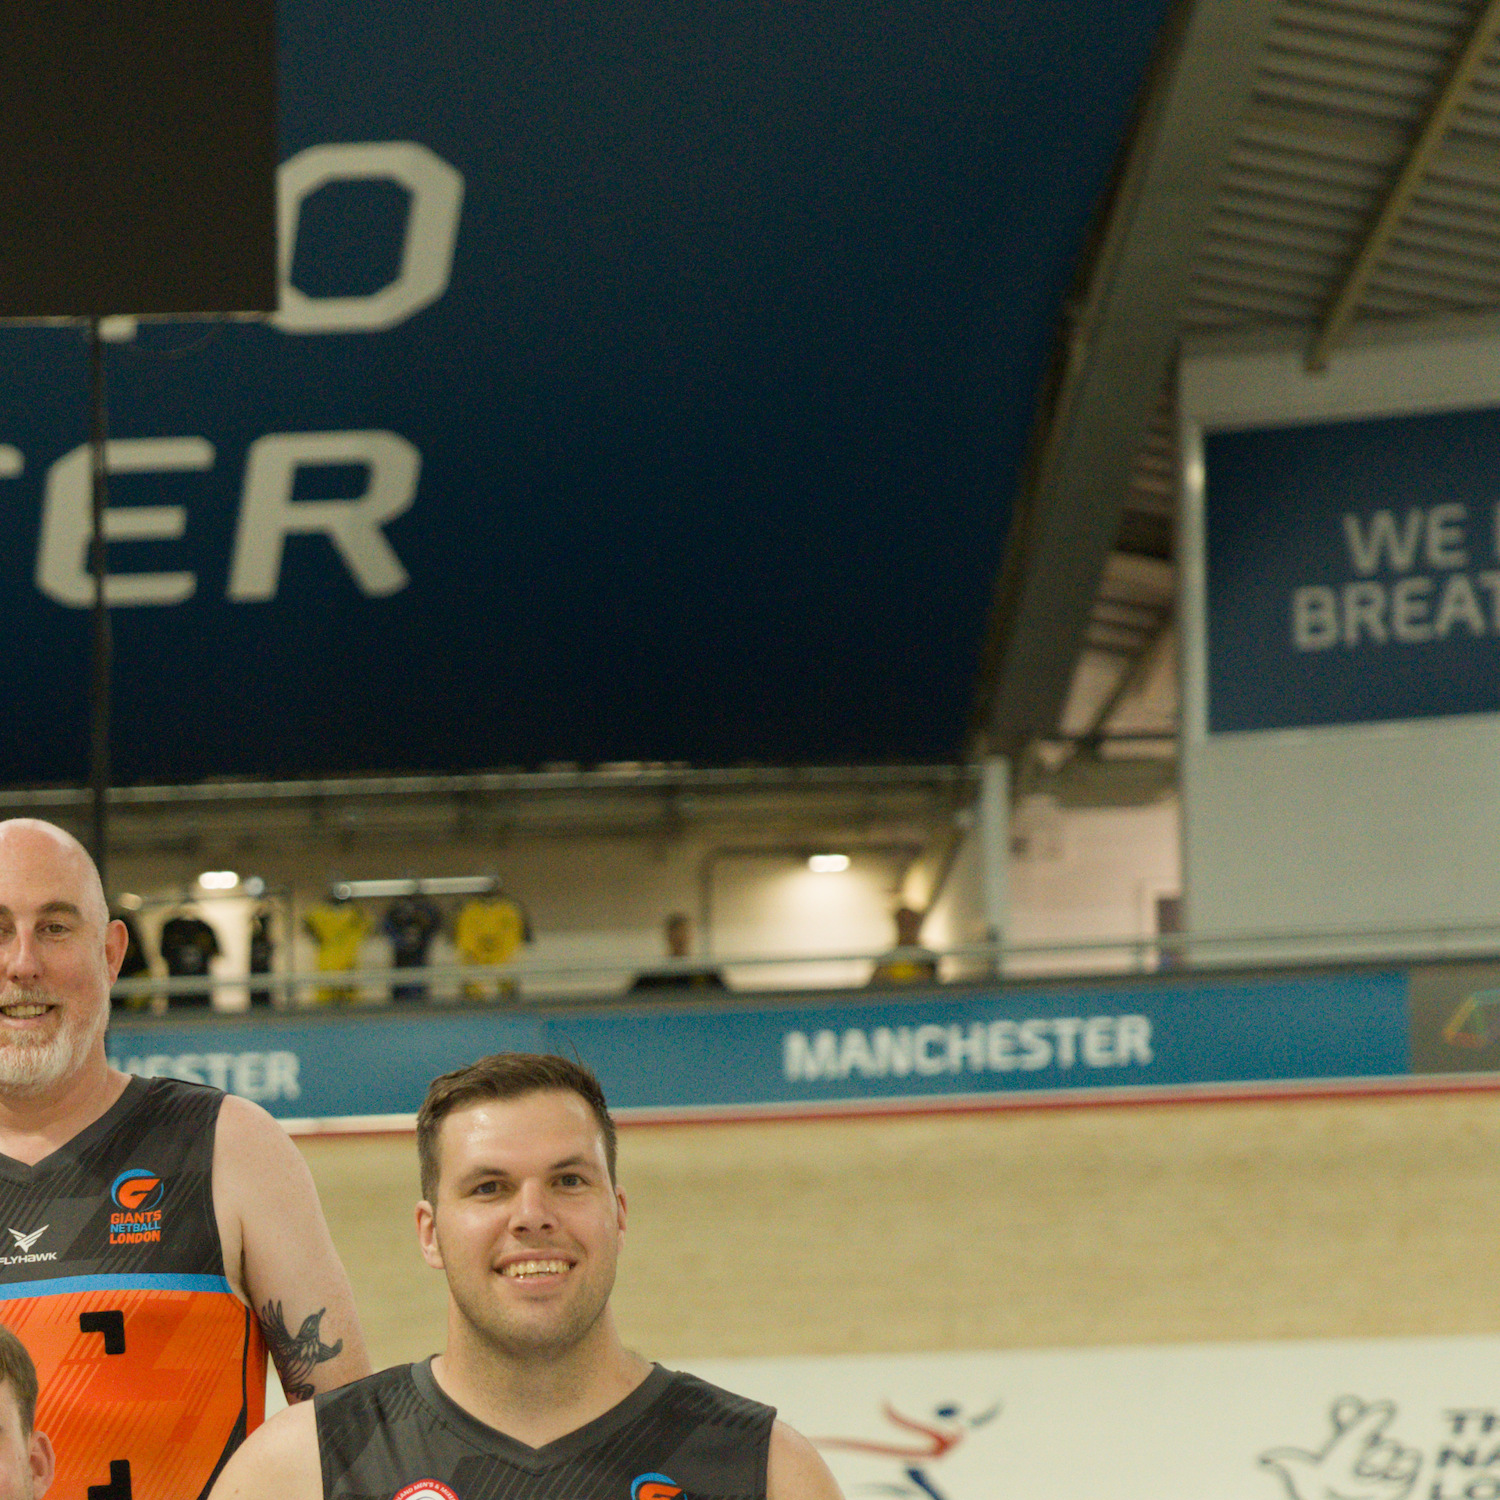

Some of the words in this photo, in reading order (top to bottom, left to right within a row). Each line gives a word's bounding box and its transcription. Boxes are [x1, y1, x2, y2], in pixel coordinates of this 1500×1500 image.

[1343, 502, 1468, 577] WE
[783, 1014, 1153, 1081] MANCHESTER
[110, 1210, 161, 1225] GIANTS
[110, 1221, 161, 1233] NETBALL
[110, 1230, 161, 1244] LONDON
